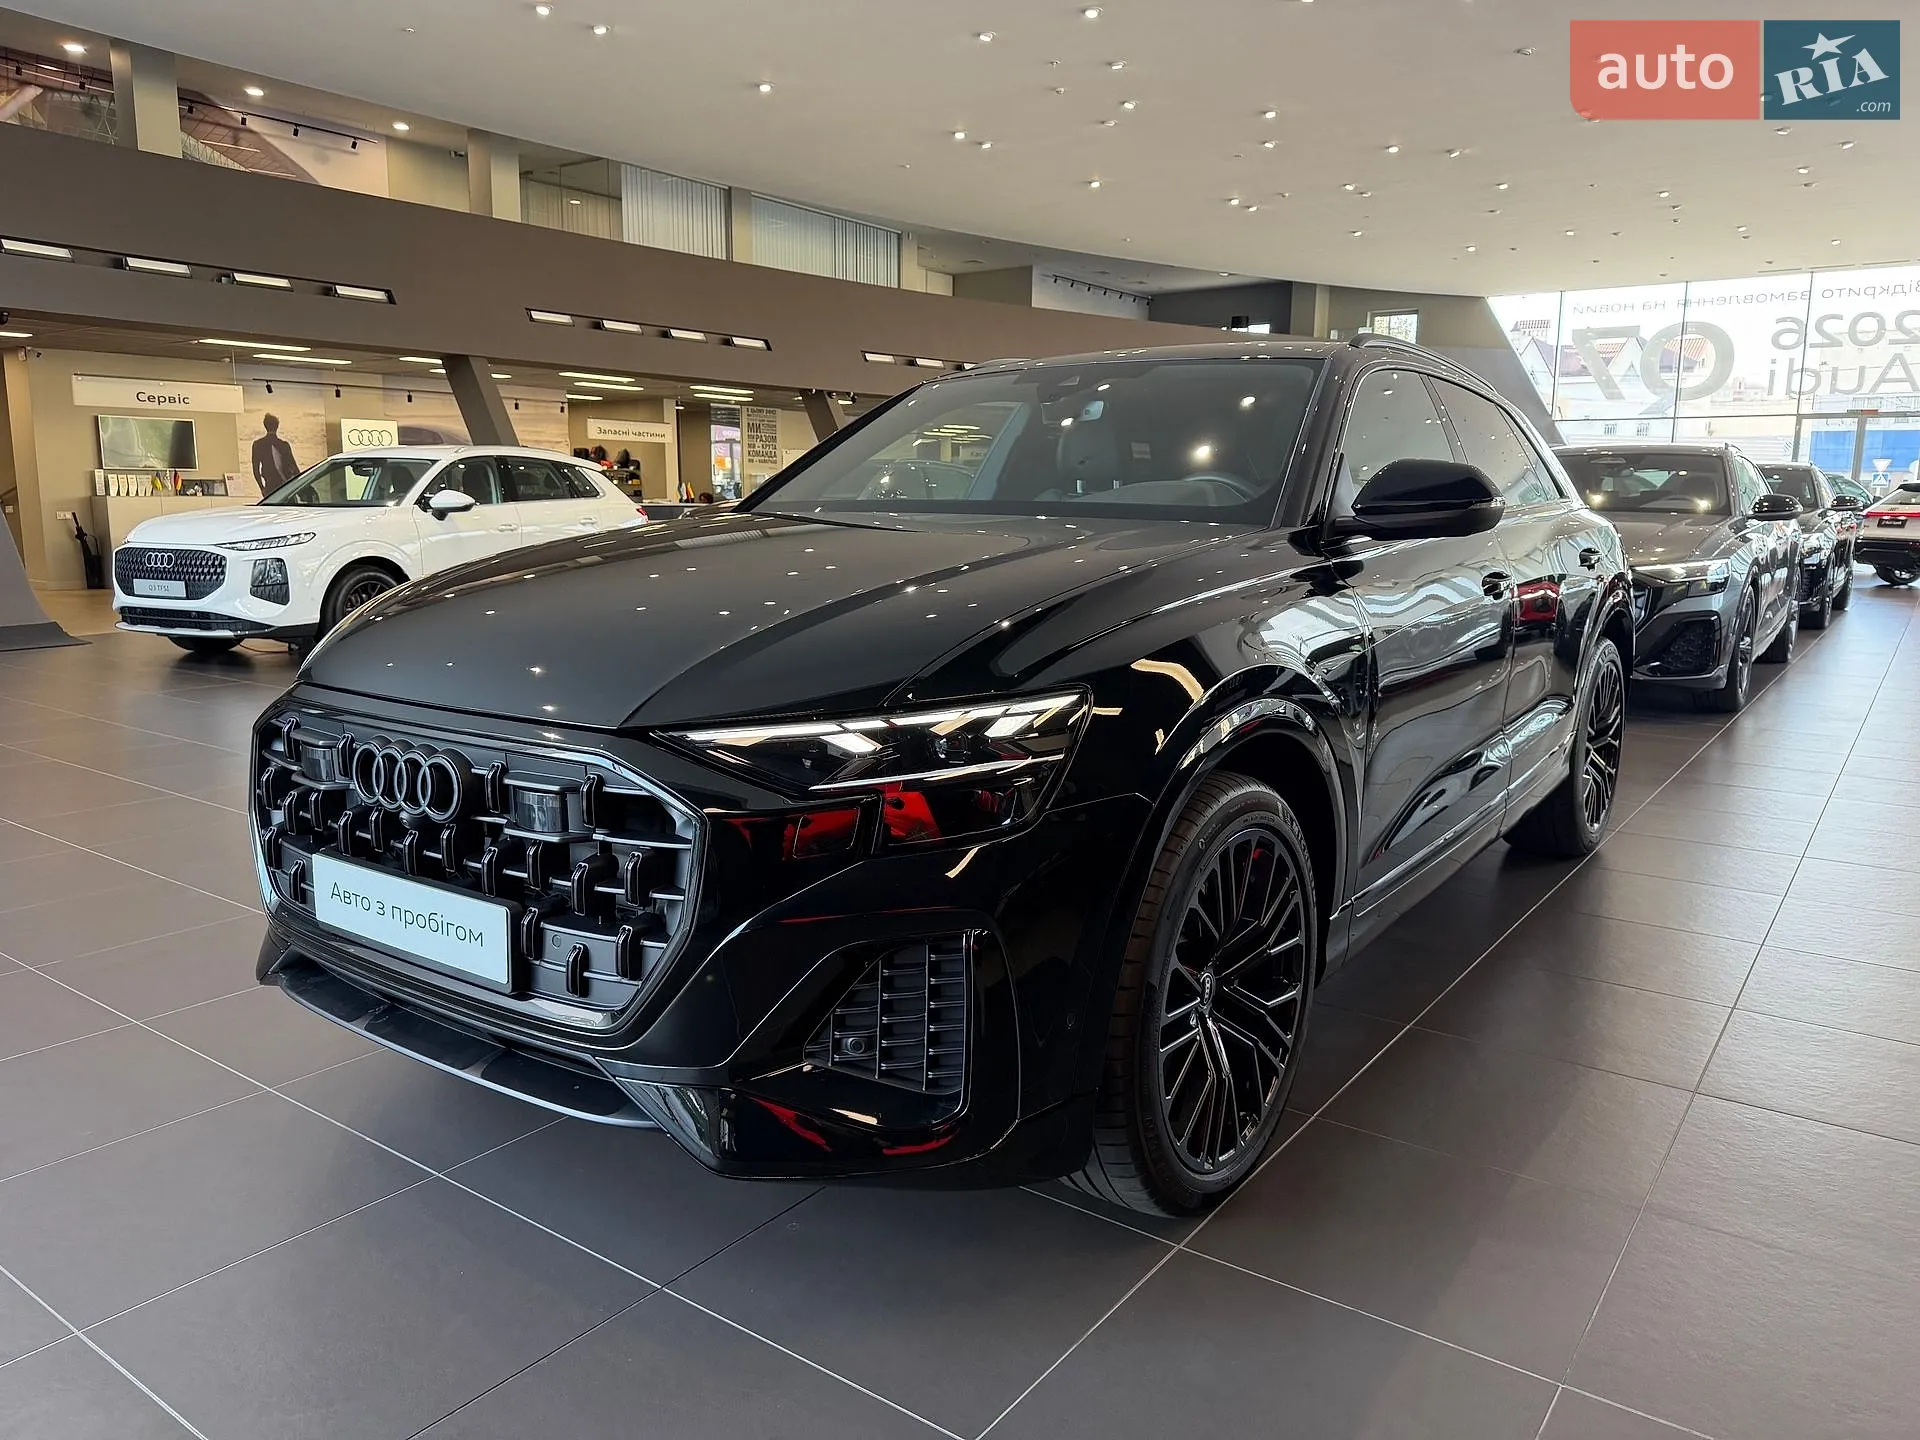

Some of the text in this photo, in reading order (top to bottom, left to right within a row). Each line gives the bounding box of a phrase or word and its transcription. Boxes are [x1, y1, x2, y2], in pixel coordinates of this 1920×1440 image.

[136, 391, 190, 405] Сервіс
[597, 426, 666, 438] Запасні частини
[330, 882, 484, 947] Авто з пробігом
